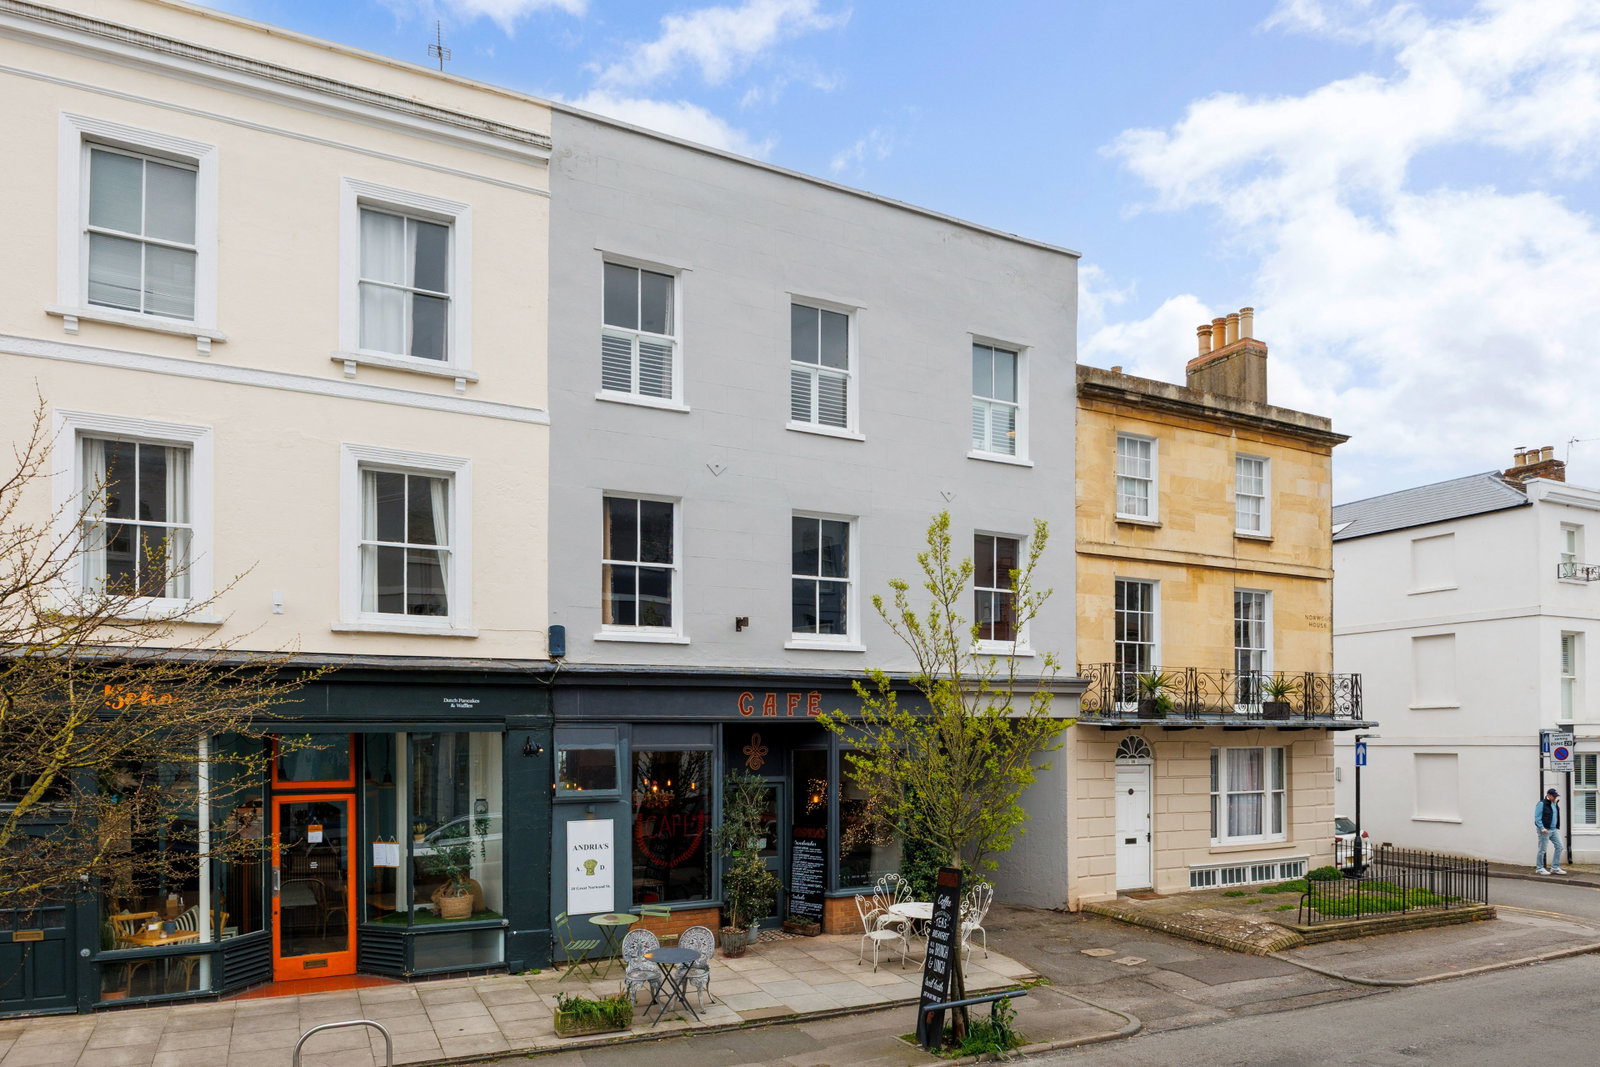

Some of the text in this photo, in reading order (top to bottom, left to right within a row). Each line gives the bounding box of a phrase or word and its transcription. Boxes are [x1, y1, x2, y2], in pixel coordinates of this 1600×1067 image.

[738, 690, 822, 717] CAFÉ
[573, 843, 610, 851] ANDRIA'S
[937, 893, 952, 907] Coffee
[935, 917, 949, 929] TEAS
